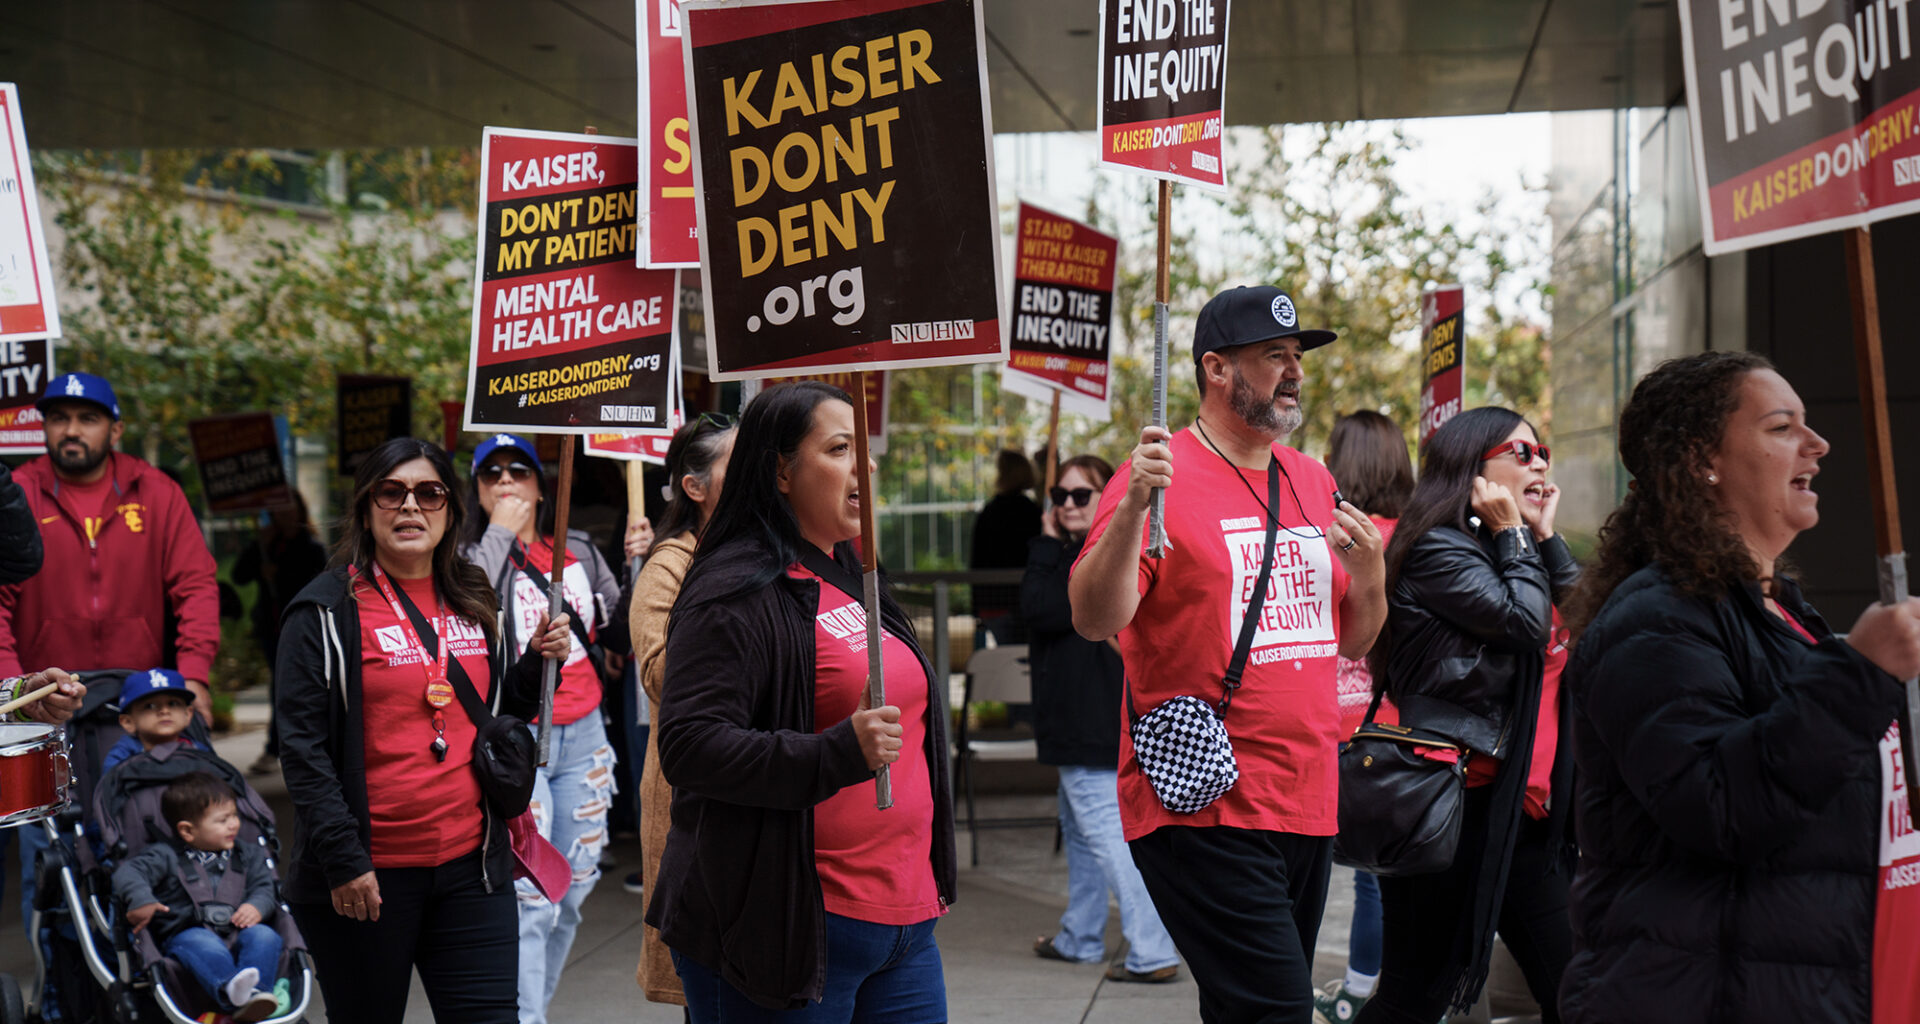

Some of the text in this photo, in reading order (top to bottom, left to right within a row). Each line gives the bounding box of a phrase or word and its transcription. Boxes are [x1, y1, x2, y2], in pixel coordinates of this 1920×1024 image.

[1117, 0, 1215, 44] END THE
[722, 28, 943, 137] KAISER
[1113, 44, 1222, 103] INEQUITY
[1112, 117, 1220, 154] KAISERDONTDENY.ORG
[502, 151, 605, 193] KAISER,
[729, 106, 900, 208] DONT
[500, 190, 638, 237] DON'T DEN
[736, 179, 897, 279] DENY
[1023, 218, 1074, 240] STAND
[497, 238, 540, 272] MY
[1023, 237, 1108, 267] WITH KAISER
[1021, 258, 1100, 286] THERAPISTS
[493, 275, 599, 319] MENTAL
[746, 266, 866, 333] .org
[1020, 284, 1101, 321] END THE
[492, 309, 592, 353] HEALTH
[596, 296, 662, 334] CARE
[892, 320, 974, 343] NUHW
[1016, 314, 1107, 351] INEQUITY
[65, 374, 84, 396] LA
[488, 353, 661, 396] KAISERDONTDENY.org
[518, 374, 633, 408] #KAISERDONTDENY
[601, 406, 656, 421] NUHW
[1241, 569, 1316, 604] ED THE
[1250, 643, 1338, 666] KAISERDONTDENY.ORG
